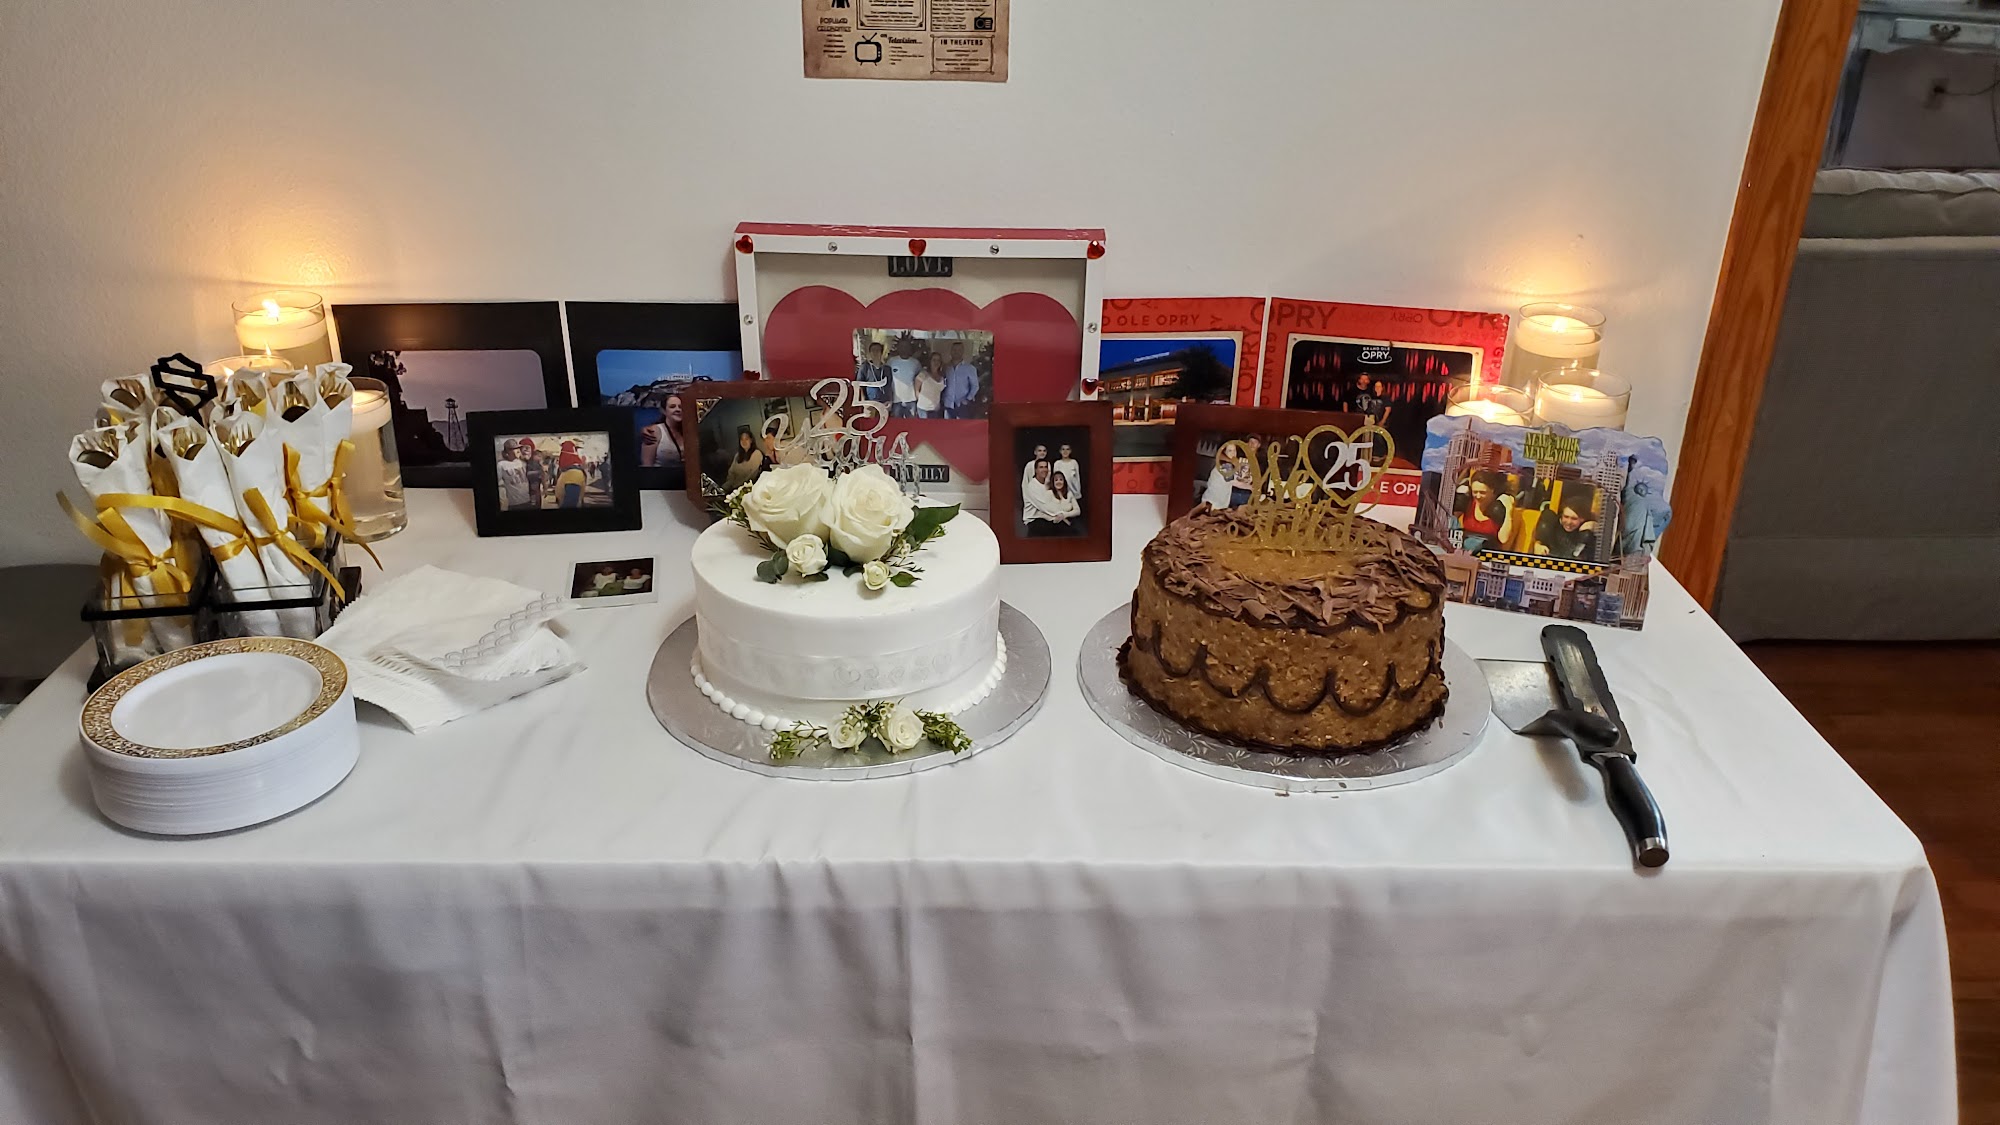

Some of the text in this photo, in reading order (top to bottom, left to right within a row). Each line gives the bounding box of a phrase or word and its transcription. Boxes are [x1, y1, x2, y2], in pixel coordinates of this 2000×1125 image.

[891, 257, 949, 273] LOVE
[1116, 315, 1150, 327] OLE
[1155, 314, 1200, 327] OPRY
[1361, 351, 1390, 360] OPRY
[810, 377, 890, 436] 25
[1555, 435, 1581, 451] YORK
[1553, 448, 1579, 465] YORK
[1321, 441, 1374, 491] 25
